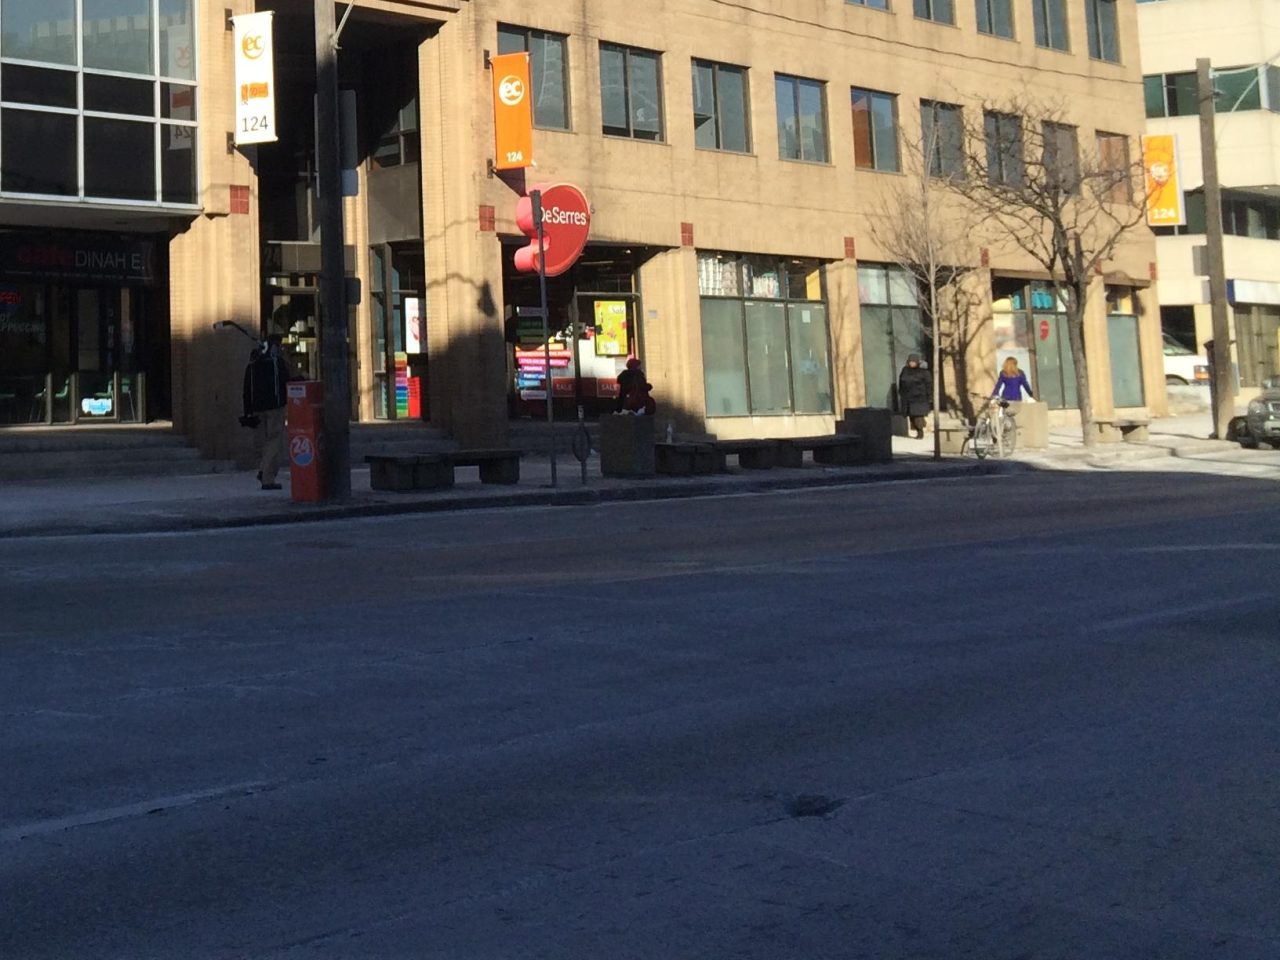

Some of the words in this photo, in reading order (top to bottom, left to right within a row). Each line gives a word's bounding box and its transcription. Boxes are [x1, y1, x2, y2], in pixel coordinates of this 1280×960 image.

[241, 115, 269, 133] 124
[506, 151, 523, 163] 124
[1153, 207, 1176, 220] 124
[74, 249, 128, 270] DINAH
[292, 437, 310, 453] 24
